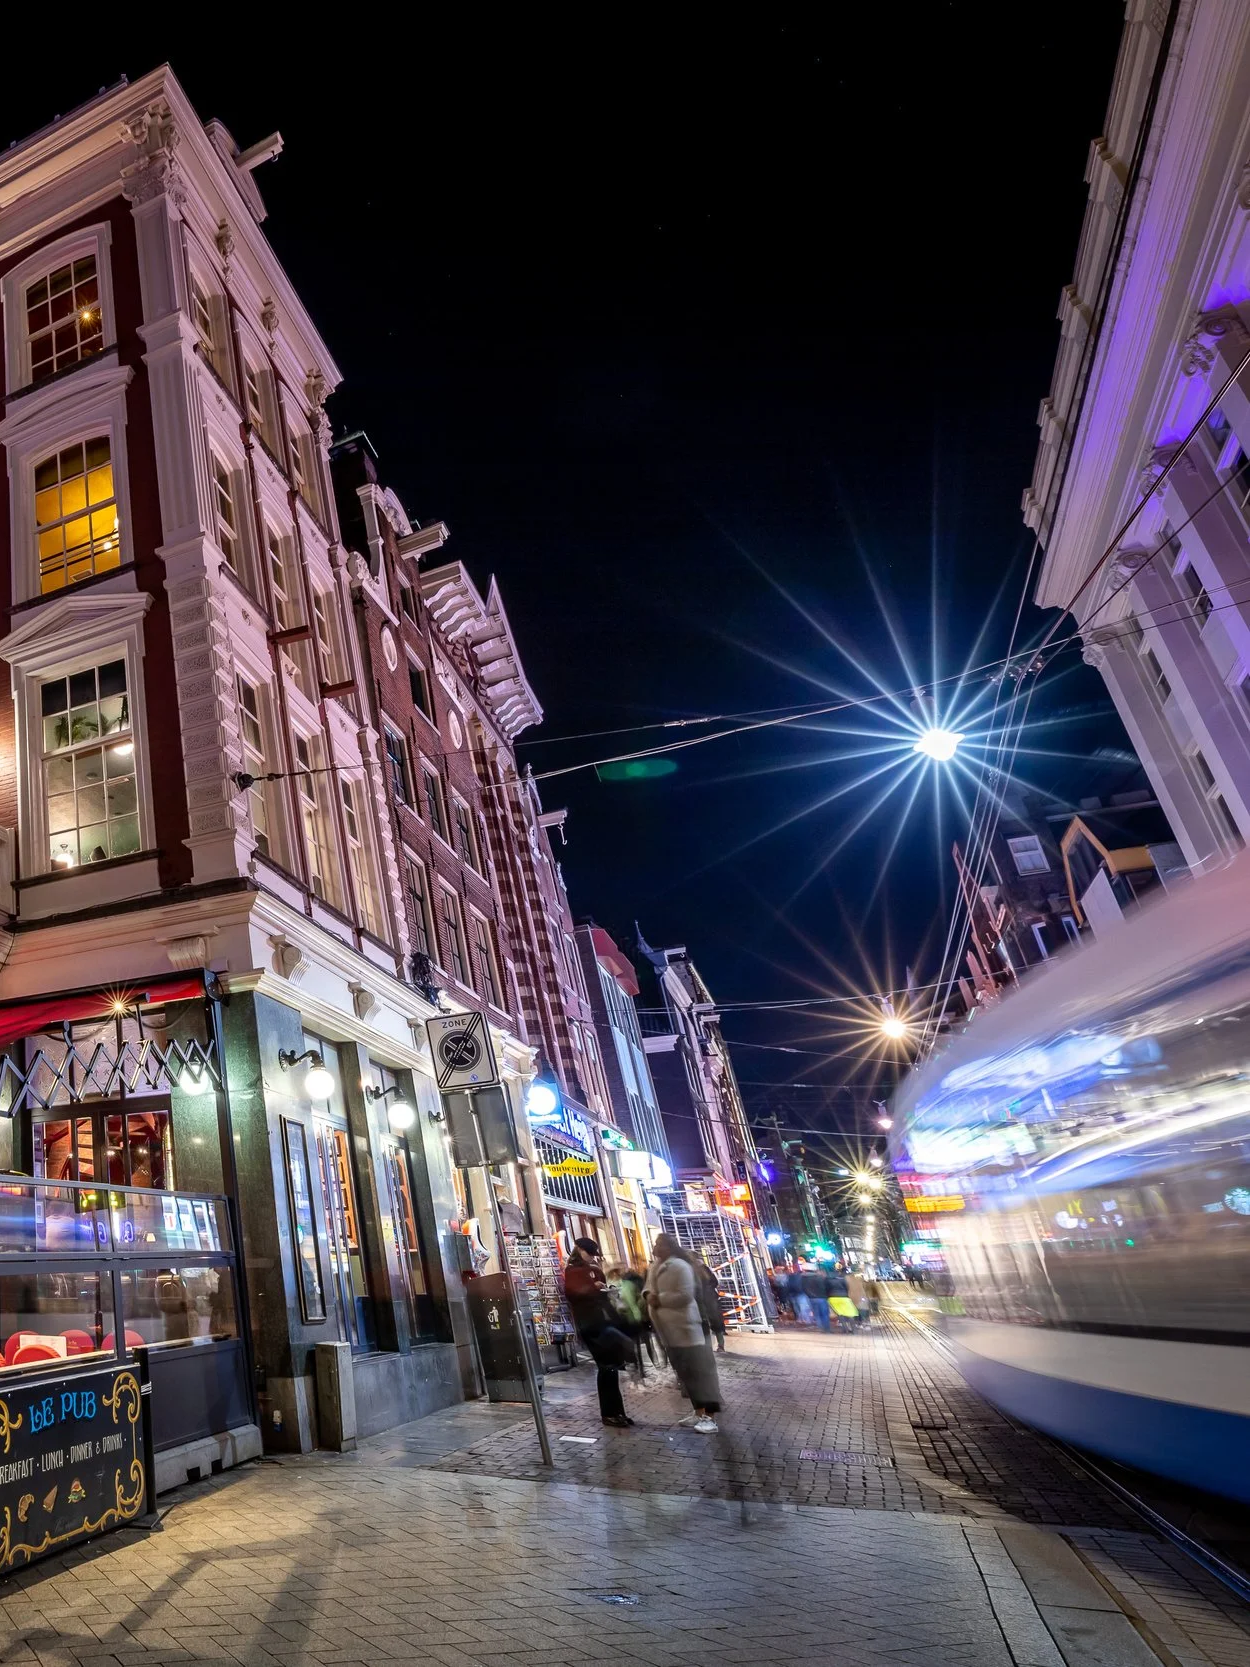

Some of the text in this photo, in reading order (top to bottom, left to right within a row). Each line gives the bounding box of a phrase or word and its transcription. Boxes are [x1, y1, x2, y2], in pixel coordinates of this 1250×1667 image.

[442, 1018, 468, 1029] ZONE
[547, 1164, 591, 1175] souvenirs
[29, 1391, 97, 1434] LE PUB
[41, 1449, 64, 1472] LUNCH
[70, 1441, 93, 1464] DINNER
[102, 1432, 123, 1454] DRINKS
